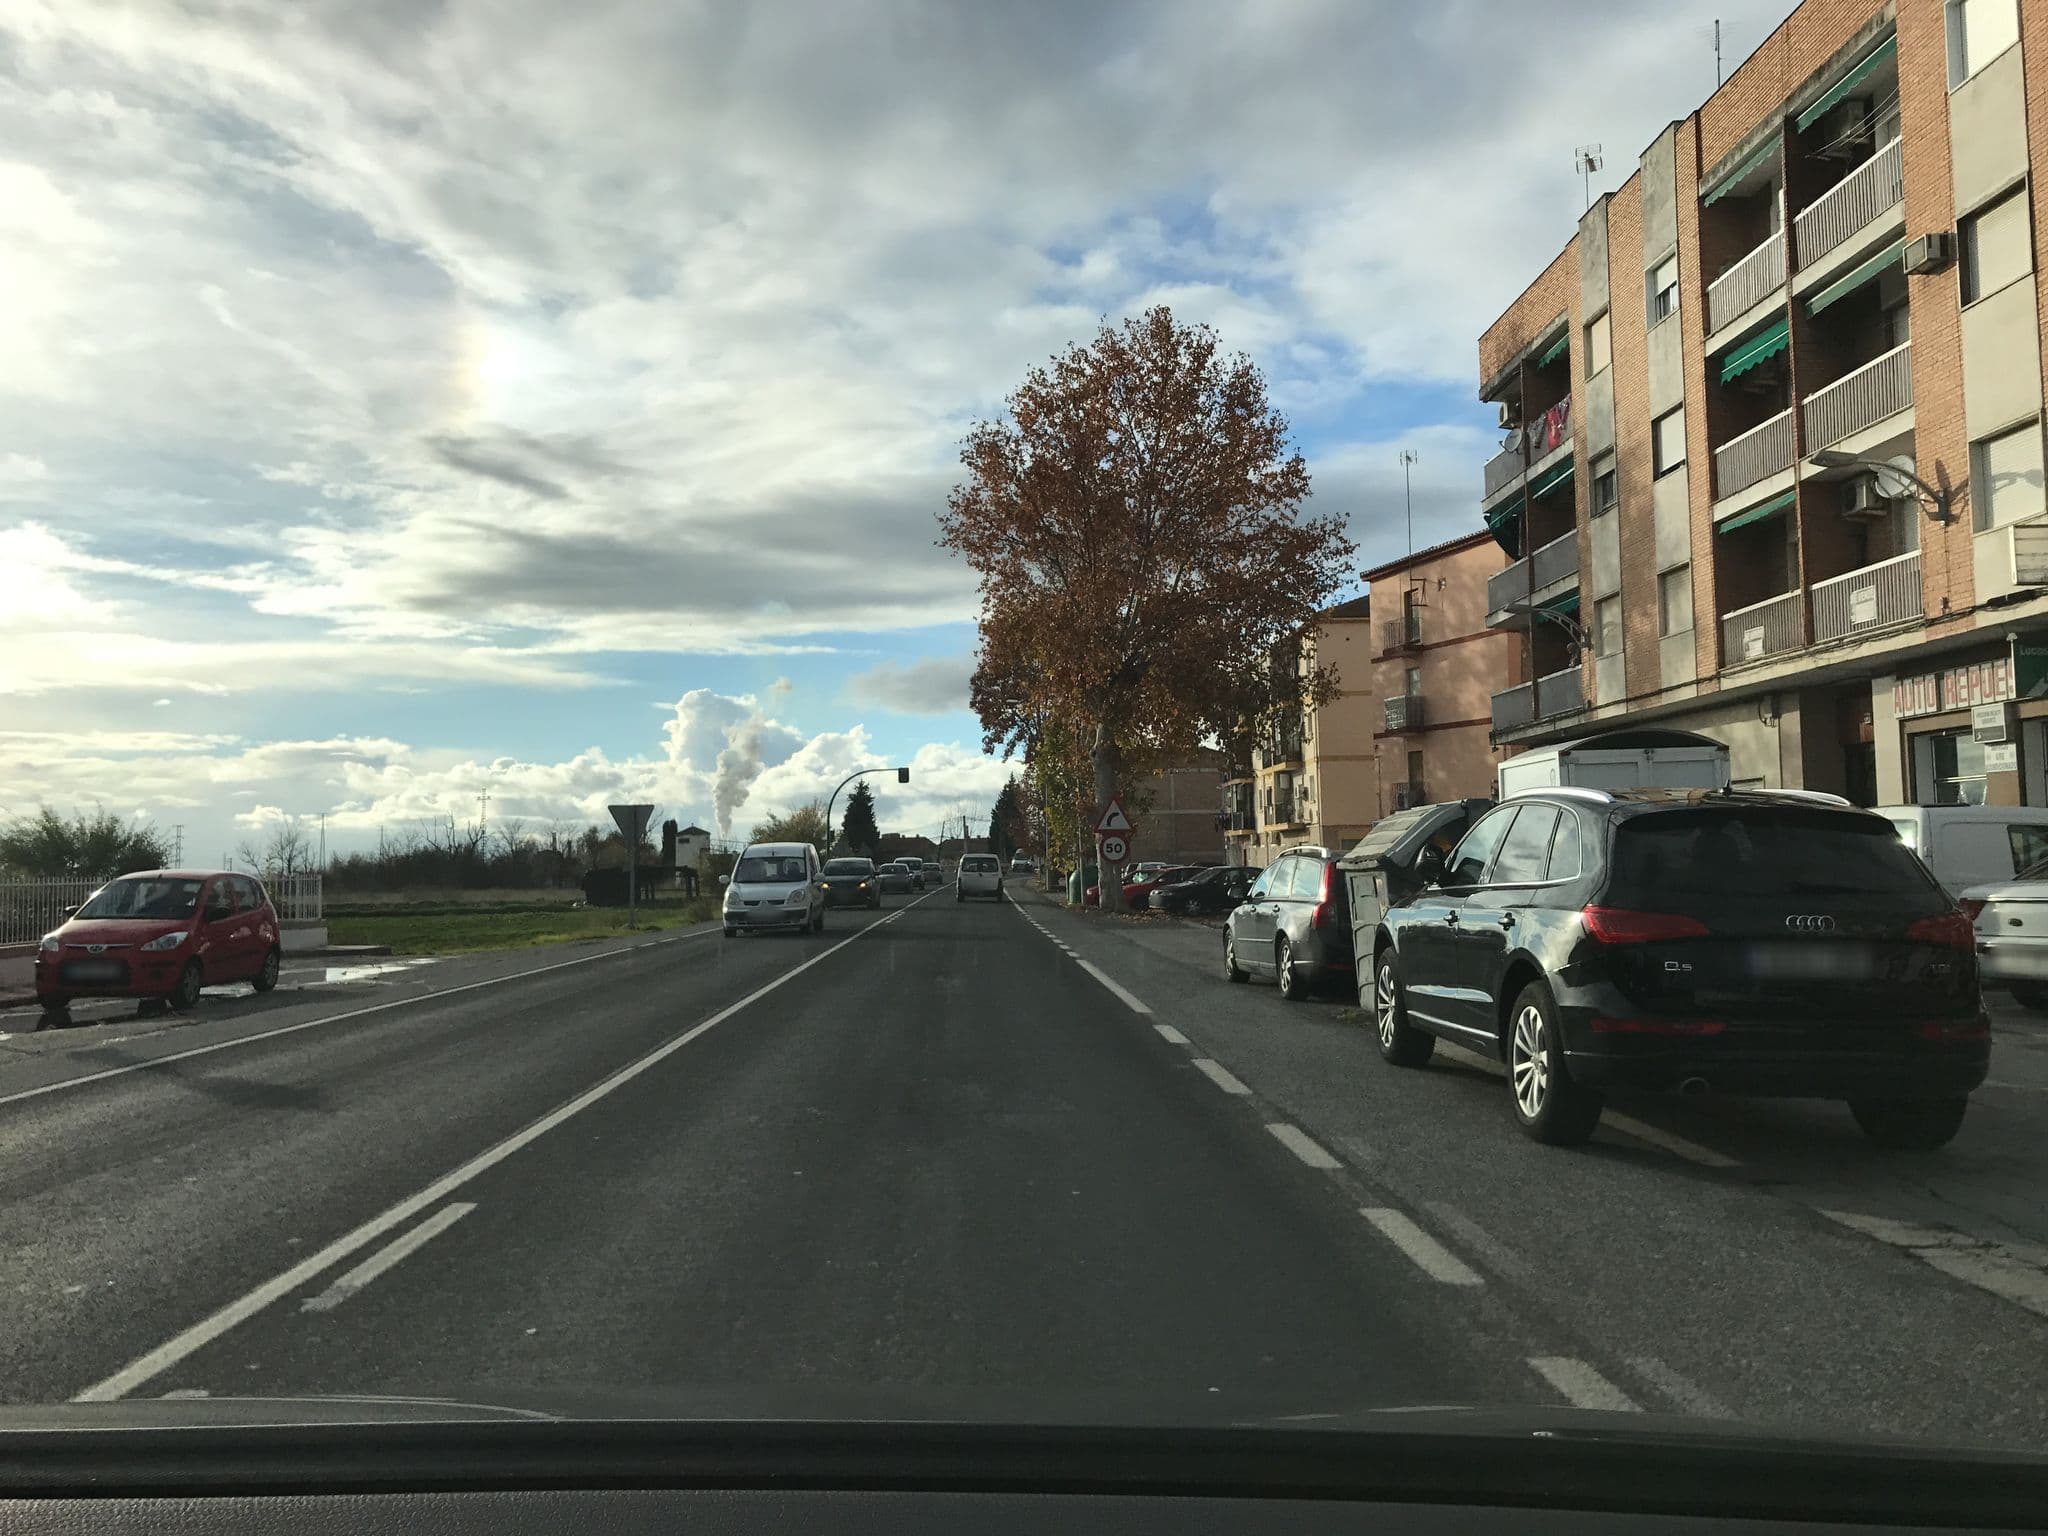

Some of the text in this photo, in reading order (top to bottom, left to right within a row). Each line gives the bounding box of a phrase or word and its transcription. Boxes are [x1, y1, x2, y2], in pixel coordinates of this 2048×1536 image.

[1893, 678, 1936, 714] AUTO
[1106, 843, 1122, 853] 50
[1664, 961, 1692, 971] Q5
